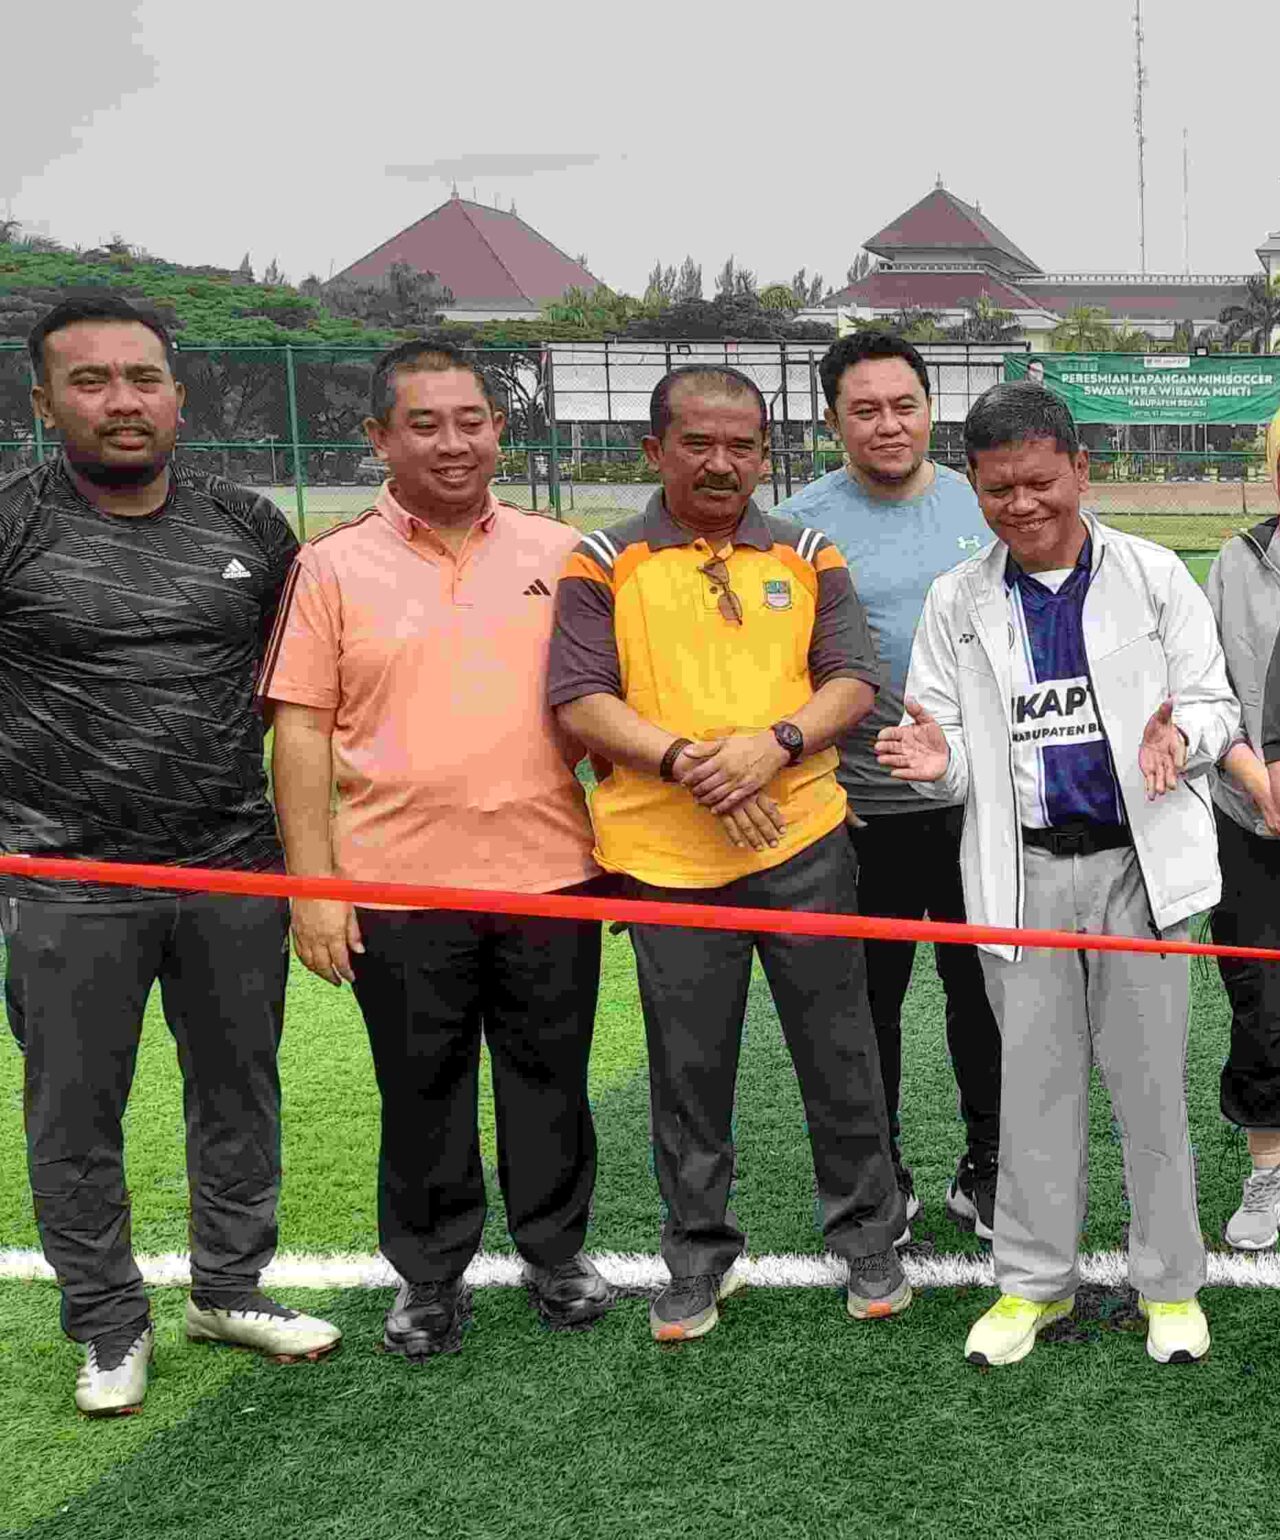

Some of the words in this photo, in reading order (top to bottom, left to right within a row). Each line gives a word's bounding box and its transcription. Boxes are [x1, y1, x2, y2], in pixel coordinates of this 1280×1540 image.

[1061, 373, 1129, 384] PERESMIAN
[1131, 373, 1196, 384] LAPANGAN
[1199, 374, 1273, 385] MINISOCCER
[1083, 385, 1157, 396] SWATANTRA
[1160, 386, 1208, 396] WIBAWA
[1212, 386, 1251, 397] MUKTI
[1128, 399, 1177, 407] KABUPATEN
[1178, 399, 1208, 408] BEKASI
[1012, 686, 1089, 724] KAP
[1012, 723, 1086, 742] KABUPATEN
